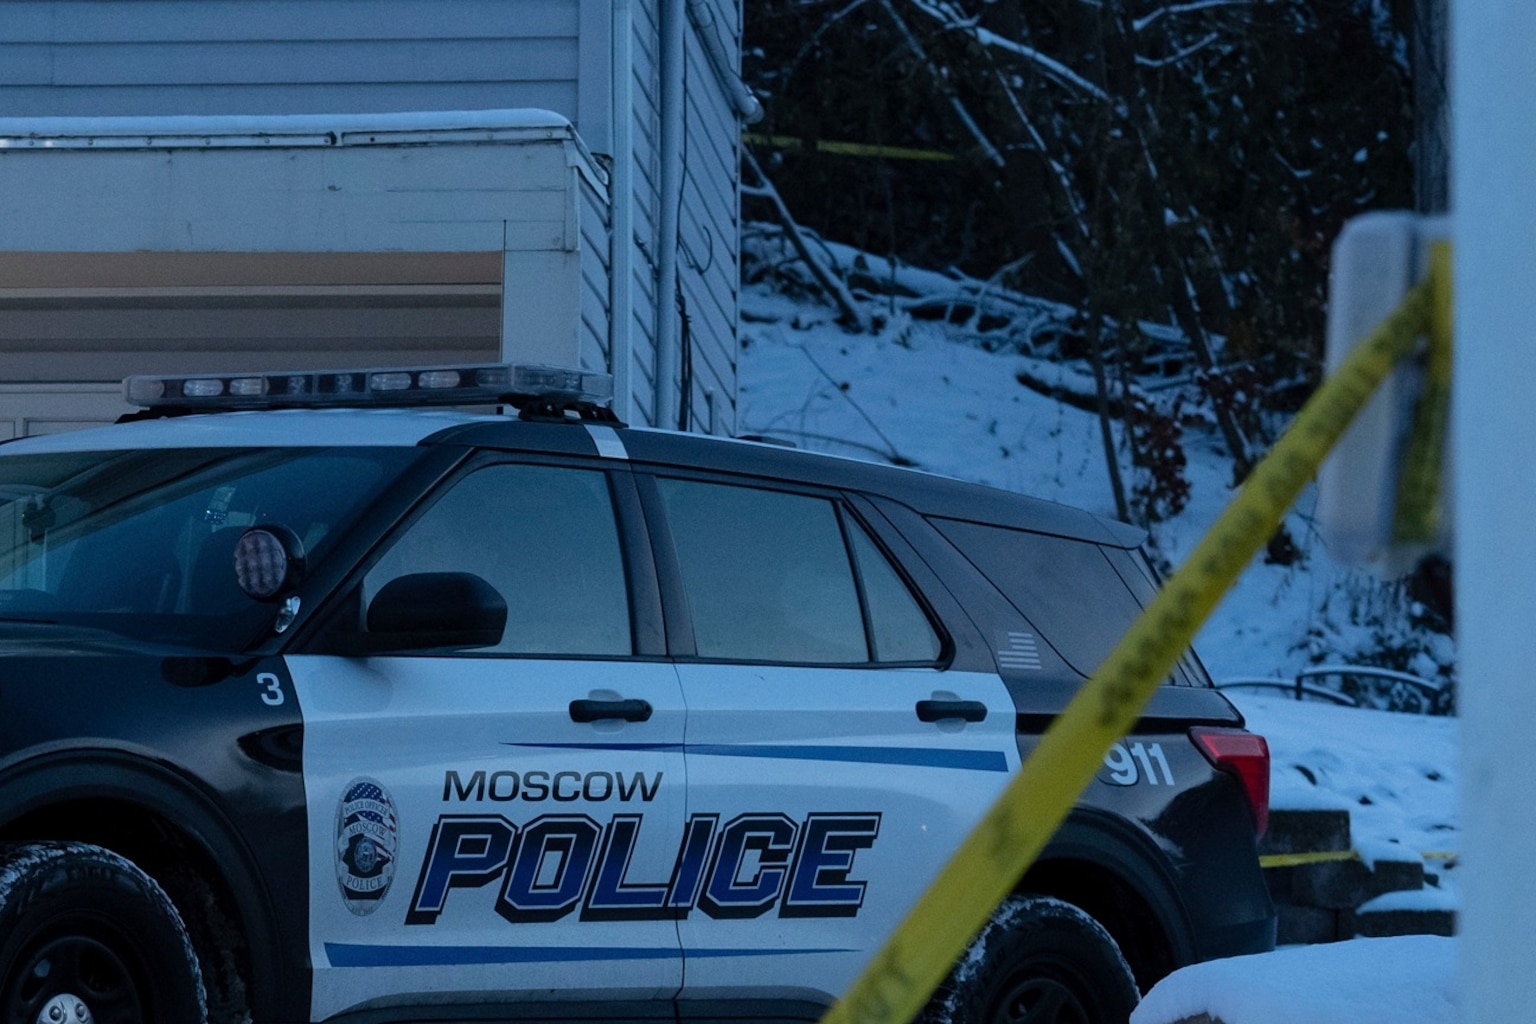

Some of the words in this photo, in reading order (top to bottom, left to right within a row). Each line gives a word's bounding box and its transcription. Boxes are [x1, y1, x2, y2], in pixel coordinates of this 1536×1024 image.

[256, 672, 285, 706] 3
[1104, 742, 1176, 786] 911
[442, 770, 663, 802] MOSCOW
[344, 800, 364, 815] POLICE
[364, 800, 388, 815] OFFICER
[349, 822, 386, 837] MOSCOW
[346, 876, 383, 890] POLICE
[404, 812, 882, 925] POLICE
